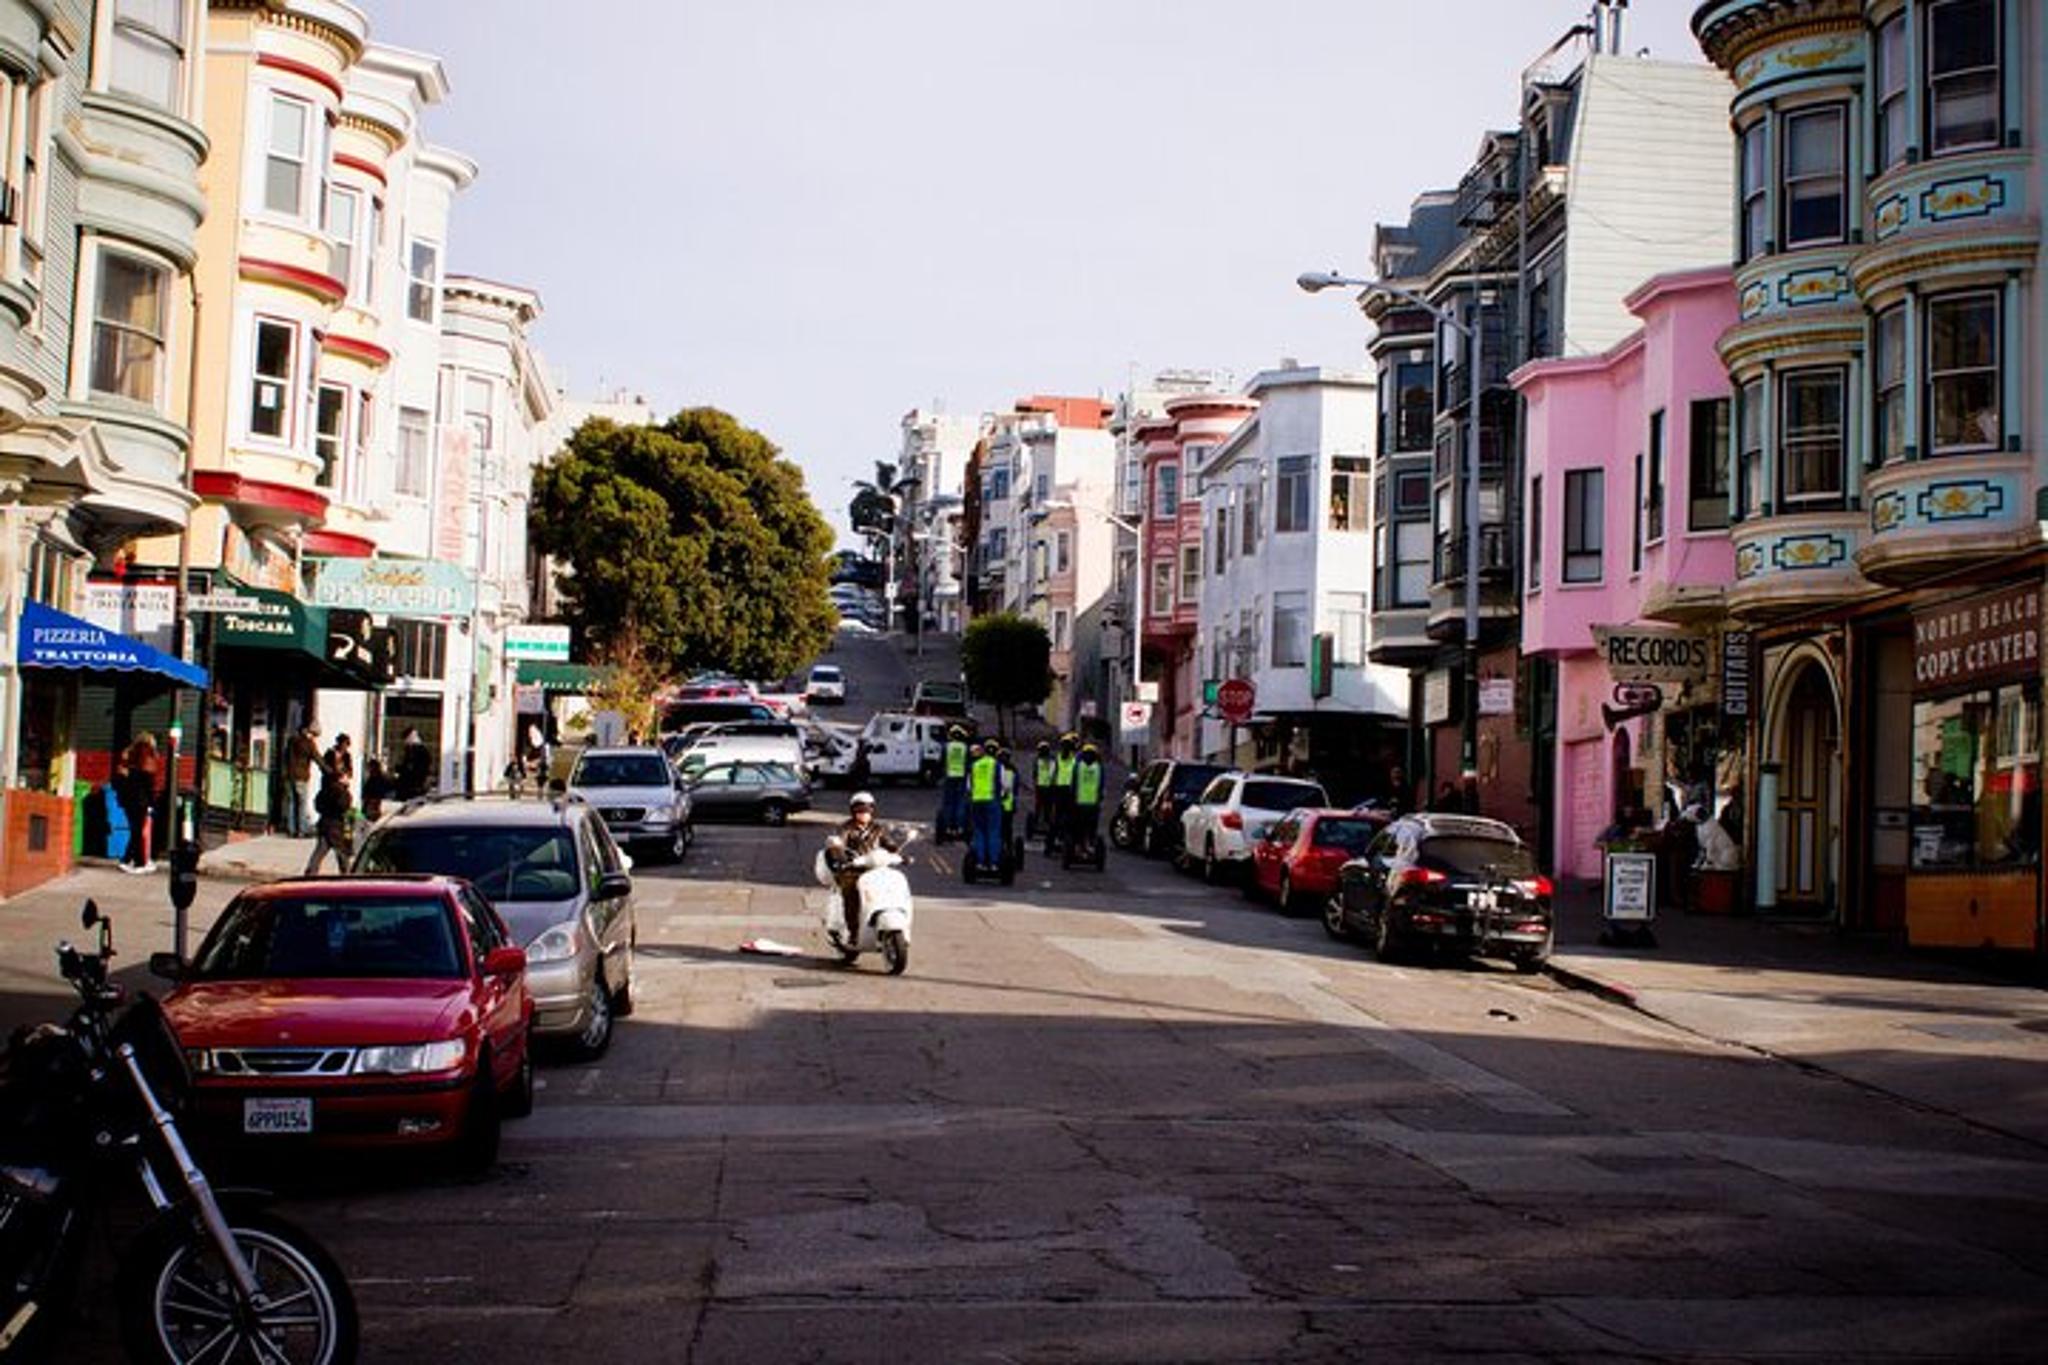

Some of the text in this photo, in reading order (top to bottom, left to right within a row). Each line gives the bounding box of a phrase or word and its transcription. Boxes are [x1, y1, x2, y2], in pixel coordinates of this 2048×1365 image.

[33, 628, 106, 645] PIZZERIA
[1916, 593, 2037, 643] NORTH BEACH
[34, 650, 138, 663] TRATTORIA
[1609, 636, 1706, 667] RECORDS
[1916, 630, 2037, 681] COPY CENTER
[1726, 633, 1748, 715] GUITARS
